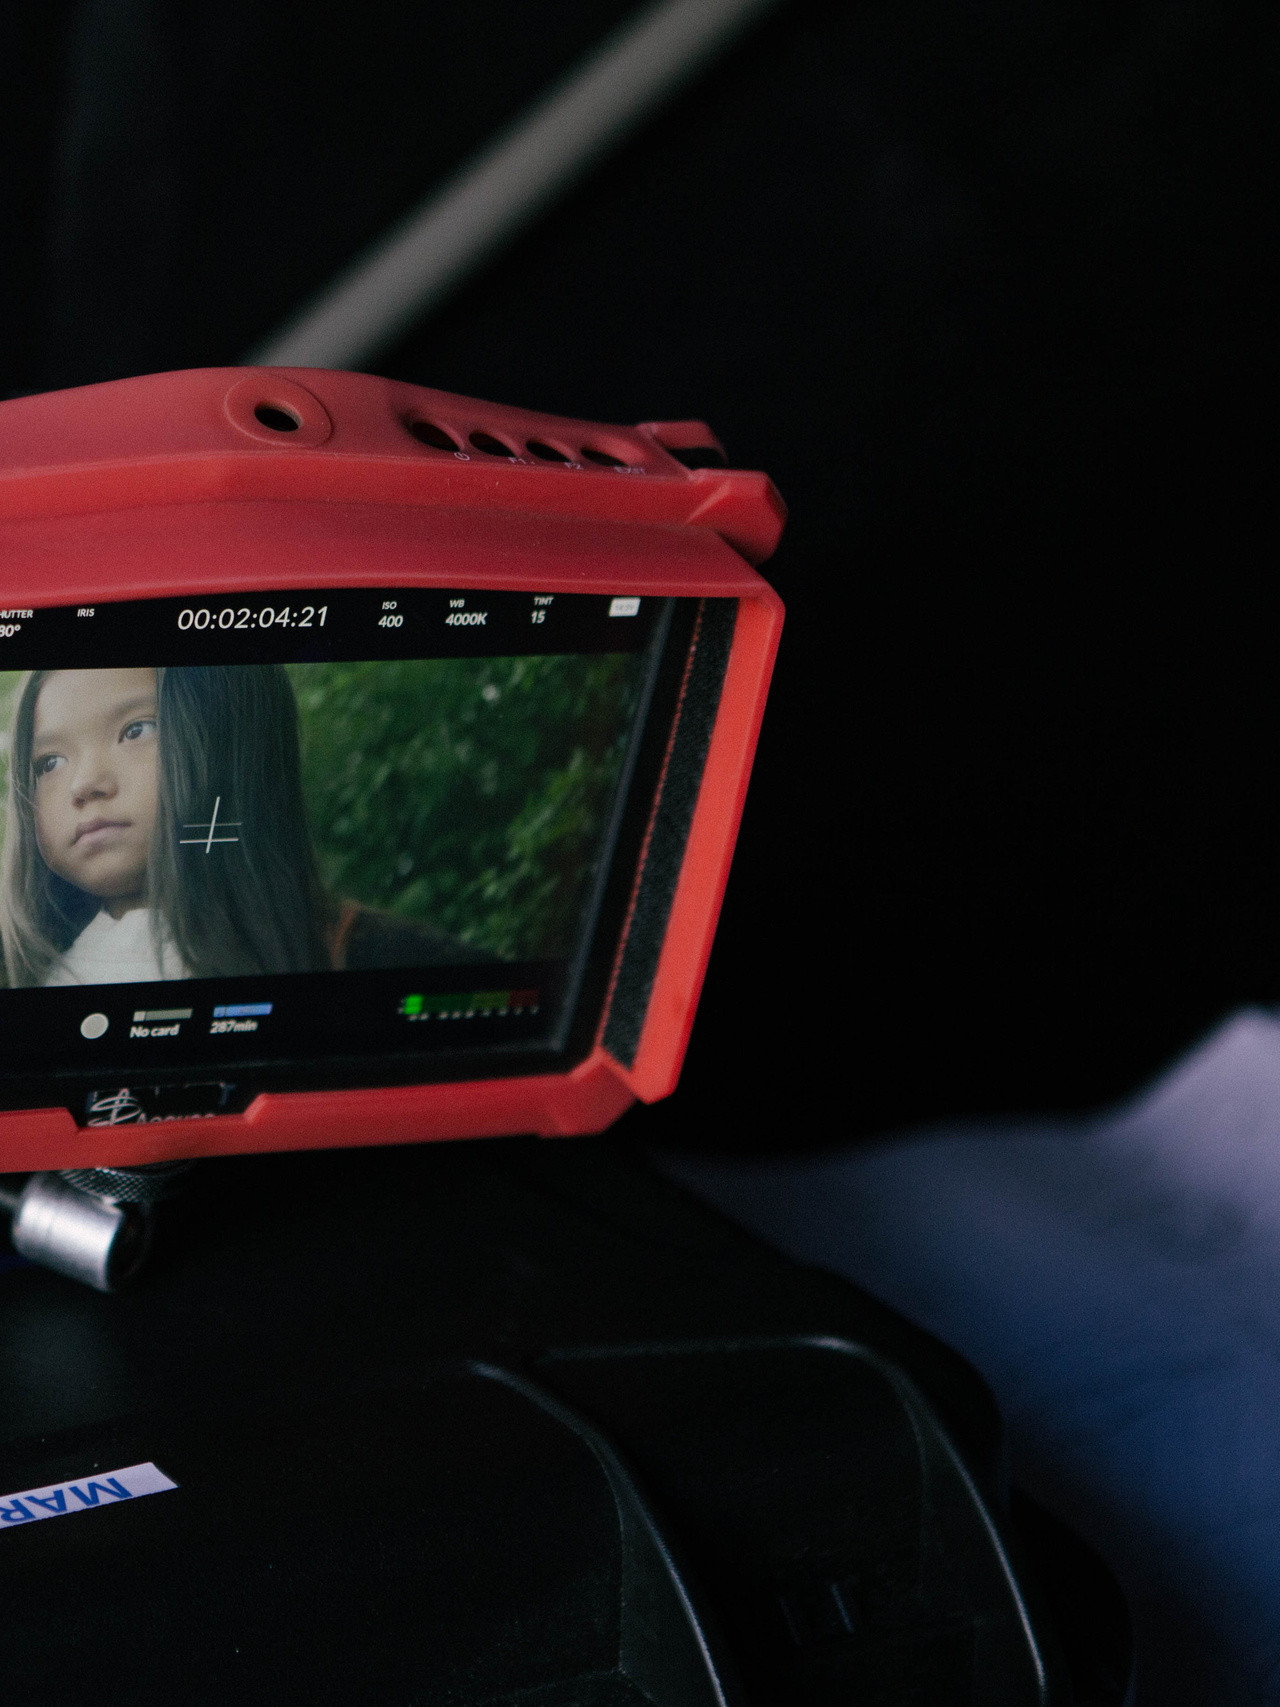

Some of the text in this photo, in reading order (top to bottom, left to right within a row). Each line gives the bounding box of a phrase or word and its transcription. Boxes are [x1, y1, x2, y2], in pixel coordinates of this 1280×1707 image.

[381, 601, 398, 610] ISO
[449, 599, 465, 609] WB
[533, 596, 554, 606] TINT
[76, 608, 96, 618] IRIS
[176, 605, 329, 631] 00:02:04:21
[445, 611, 488, 626] 4000K
[531, 609, 546, 624] 15
[377, 614, 404, 628] 400
[129, 1024, 181, 1038] No card
[208, 1020, 259, 1034] 287min
